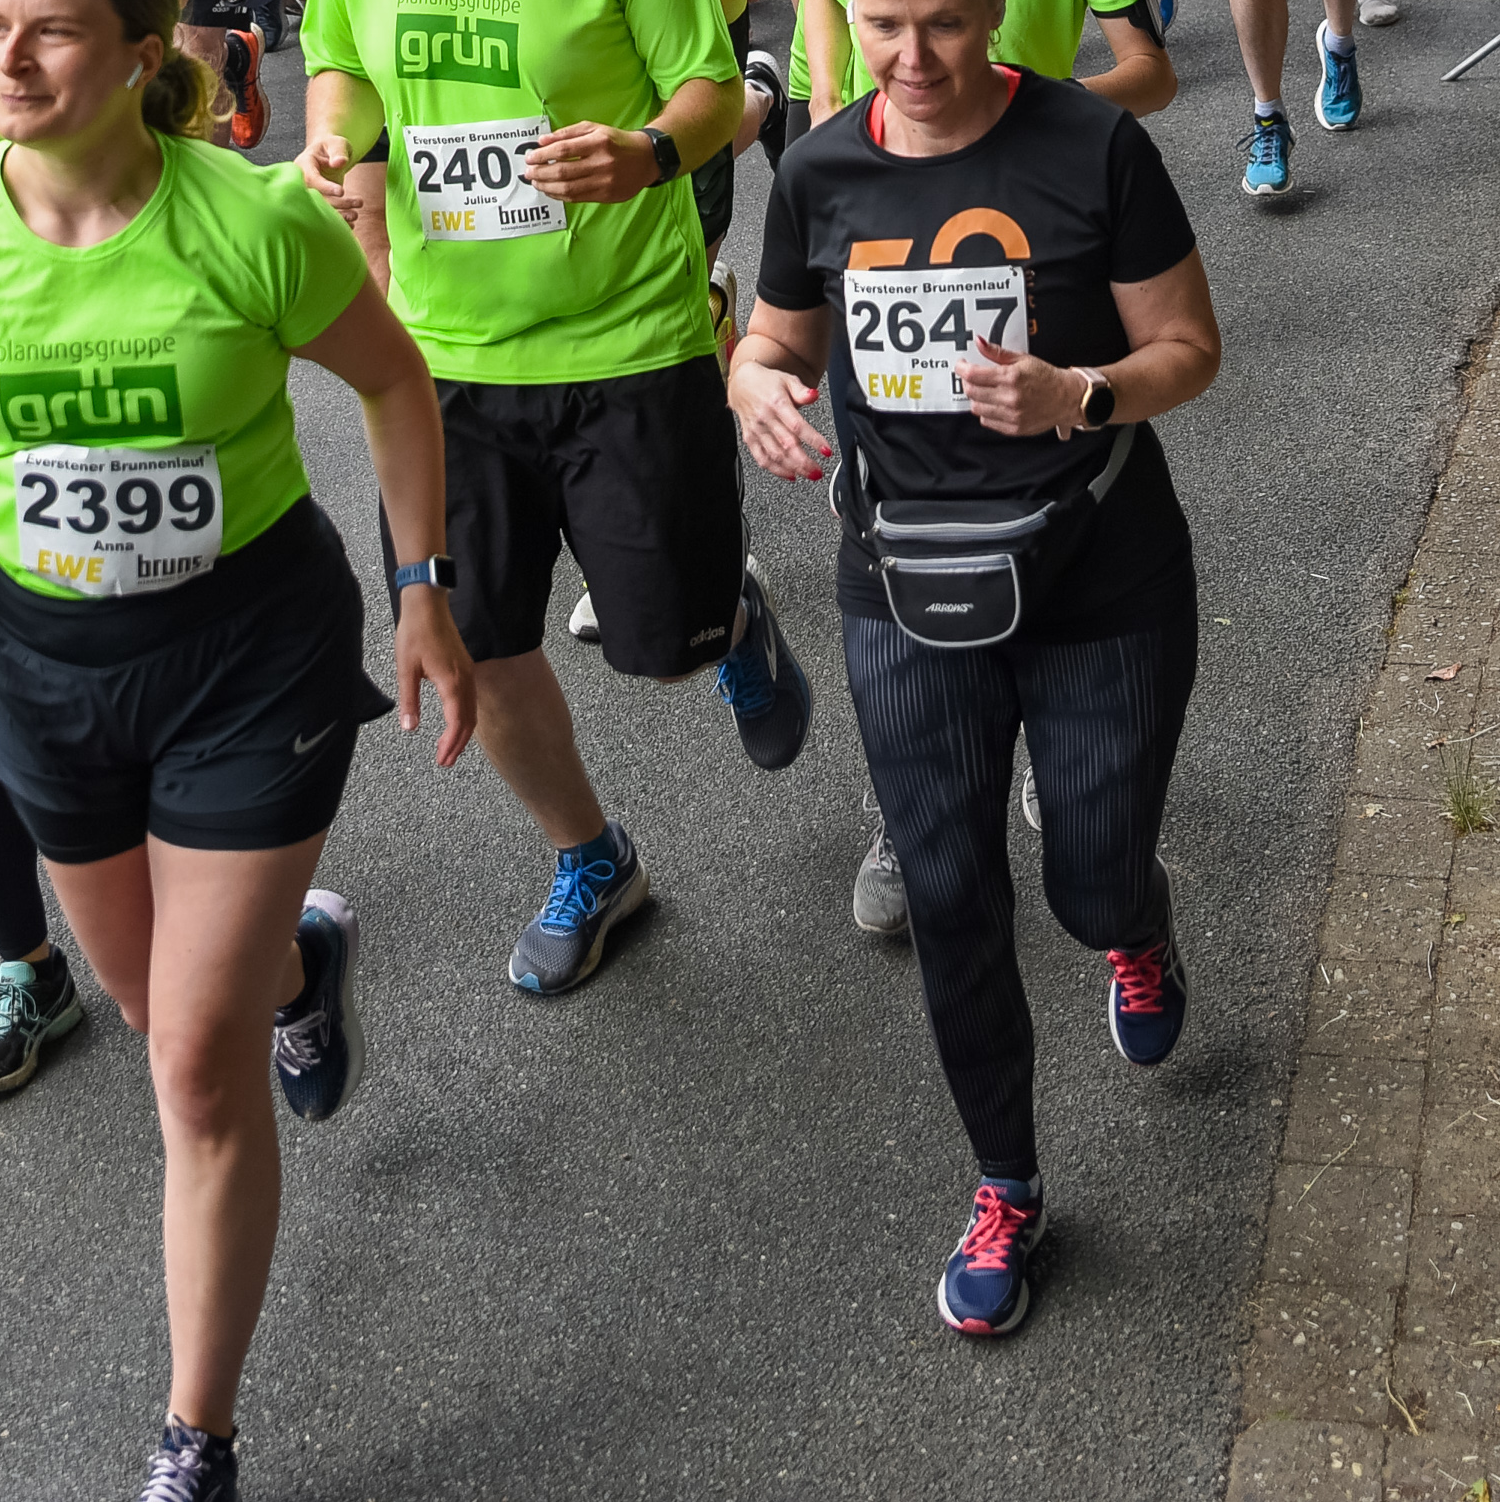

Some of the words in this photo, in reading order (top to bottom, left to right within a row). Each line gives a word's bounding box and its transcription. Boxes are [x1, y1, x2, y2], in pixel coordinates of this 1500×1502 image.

[400, 16, 510, 73] grün
[412, 133, 466, 146] Everstener
[468, 125, 541, 143] Brunnenlauf
[463, 194, 498, 206] Julius
[430, 209, 476, 232] EWE
[498, 203, 551, 226] bruns
[853, 282, 919, 294] Everstener
[922, 278, 1012, 294] Brunnenlauf
[850, 296, 1019, 354] 2647
[910, 357, 949, 369] Petra
[867, 372, 924, 400] EWE
[7, 366, 169, 438] grün
[26, 453, 106, 473] Everstener
[110, 456, 206, 472] Brunnenlauf
[20, 472, 216, 535] 2399
[93, 539, 135, 552] Anna
[36, 548, 106, 584] EWE
[137, 553, 204, 579] bruns
[690, 624, 726, 648] adidas
